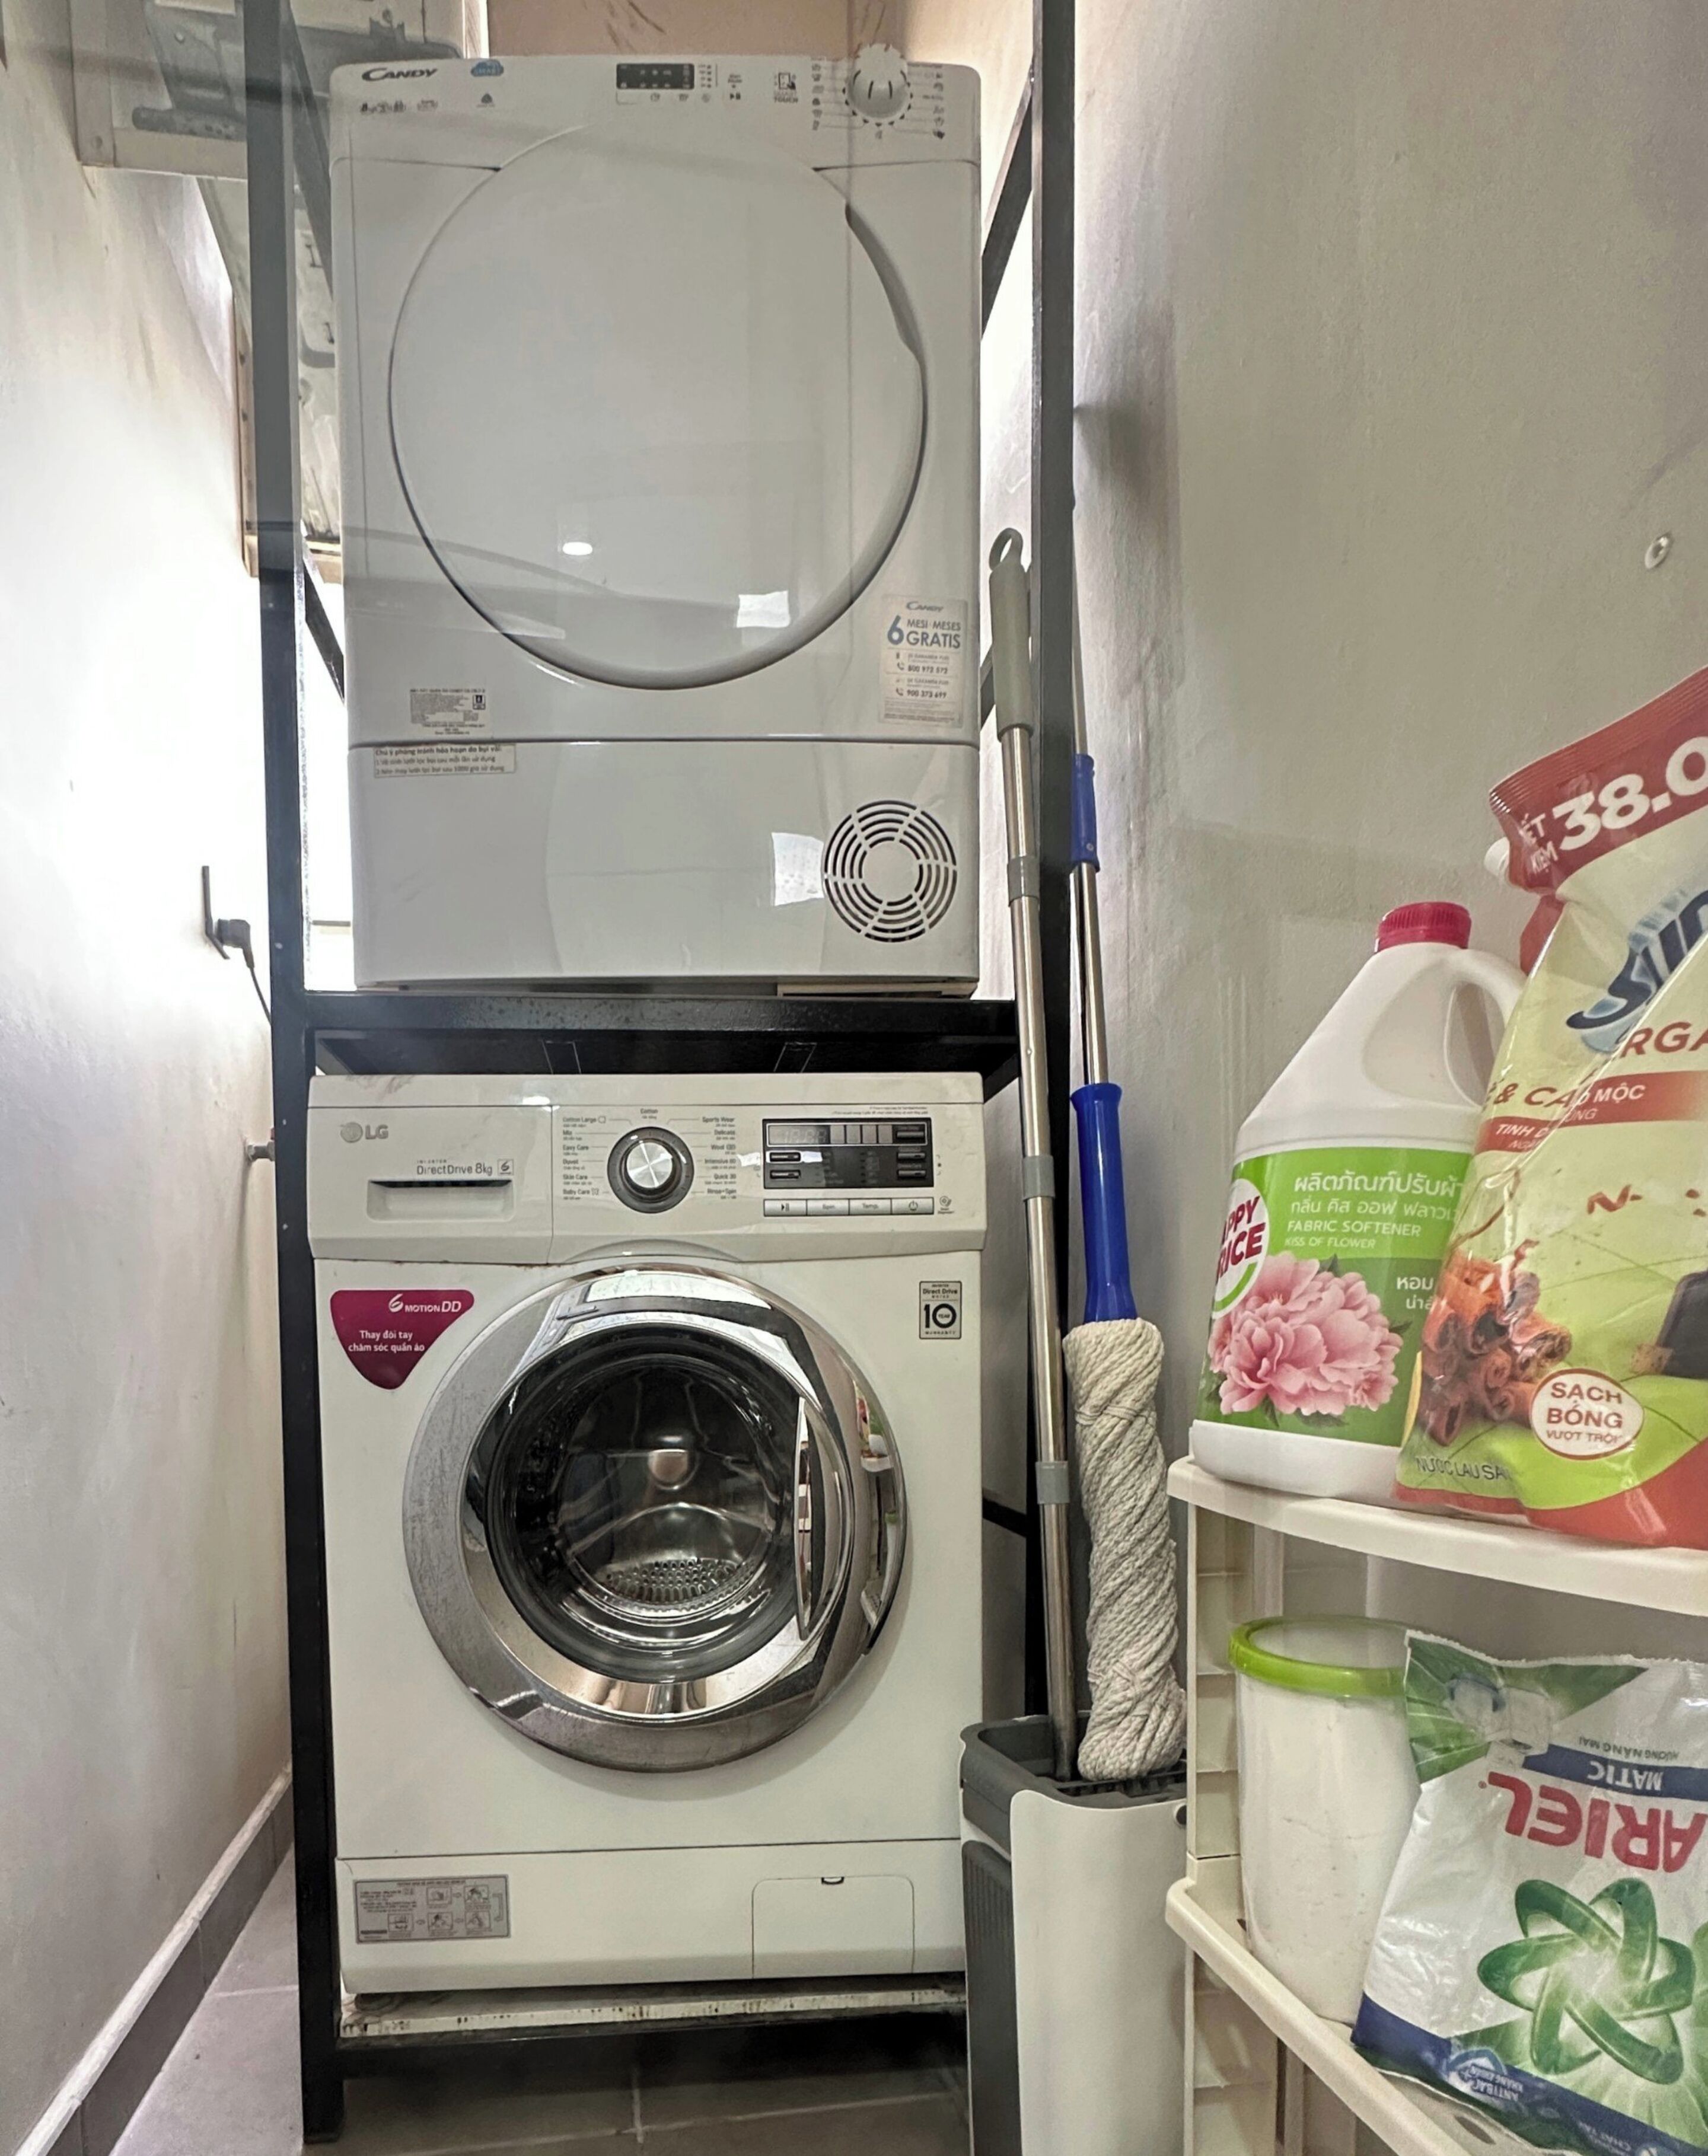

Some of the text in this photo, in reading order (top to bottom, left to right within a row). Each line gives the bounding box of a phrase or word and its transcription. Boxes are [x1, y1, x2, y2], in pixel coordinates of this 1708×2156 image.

[362, 68, 438, 81] CANDY
[887, 615, 904, 645] 6
[907, 618, 961, 632] MESI MESES
[906, 630, 961, 649] GRATIS
[1593, 1082, 1646, 1103] MỘC
[365, 1125, 388, 1139] LG
[1496, 1124, 1535, 1138] TINH
[475, 1163, 493, 1176] 8kg
[1288, 1220, 1422, 1237] FABRIC SOFTENER
[1285, 1237, 1376, 1249] KISS OF FLOWER
[923, 1303, 957, 1328] 10
[359, 1330, 381, 1341] Thay
[399, 1331, 413, 1341] tay
[1546, 1398, 1623, 1429] BÓNG
[1586, 1760, 1664, 1791] MATIC
[1487, 1771, 1708, 1873] ARIEL
